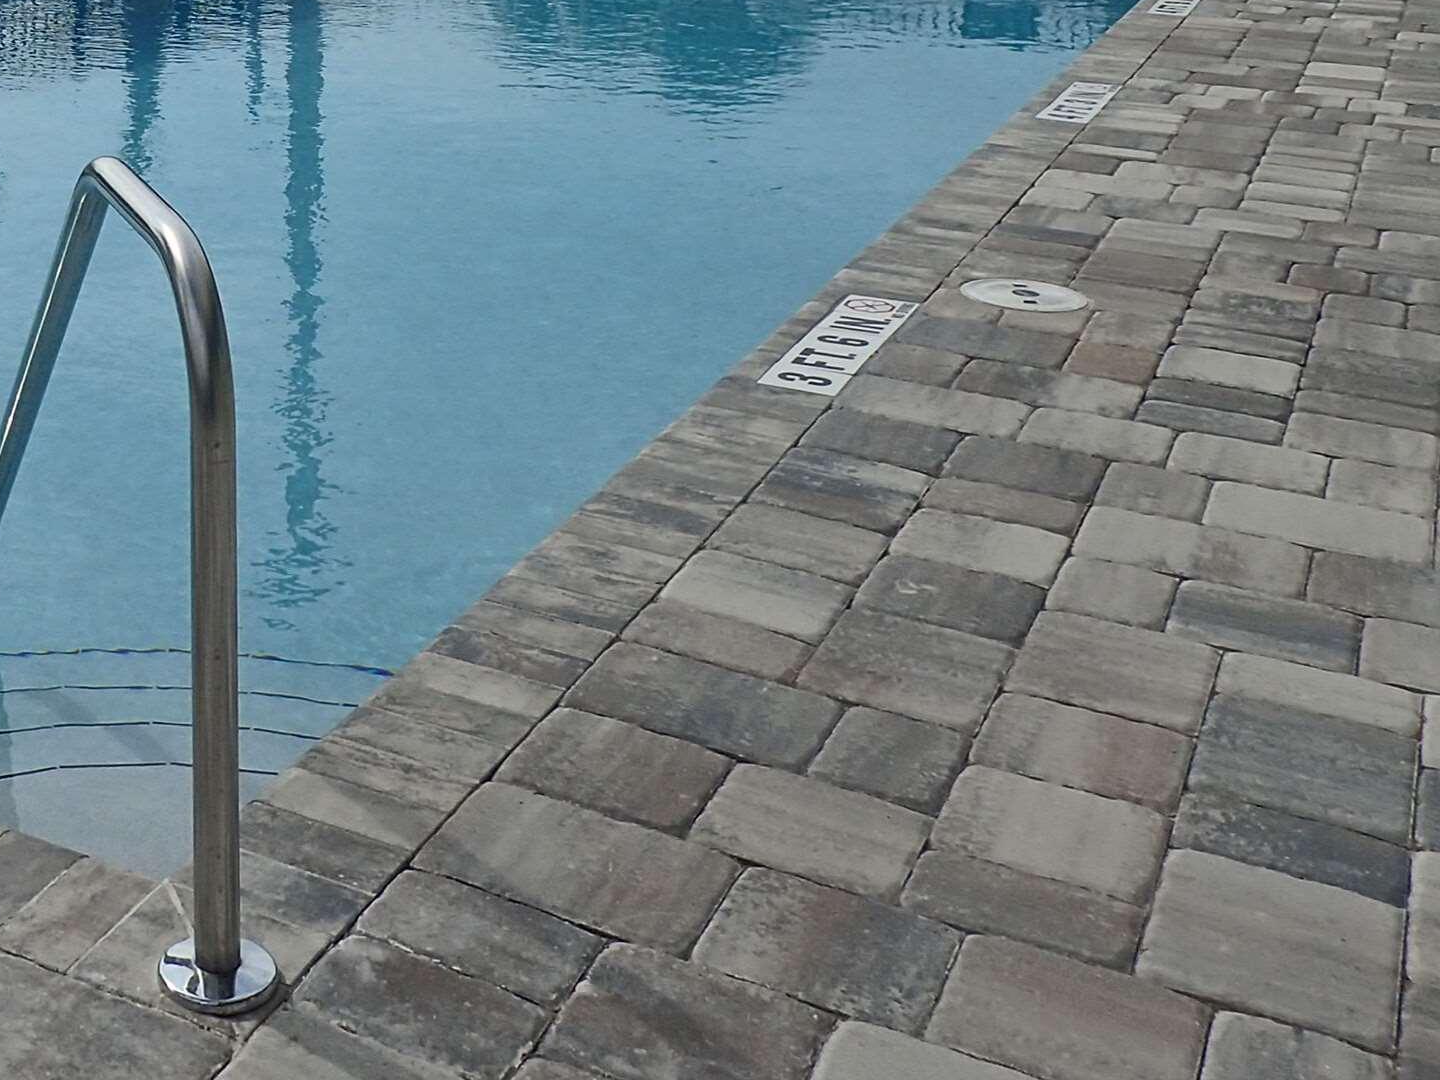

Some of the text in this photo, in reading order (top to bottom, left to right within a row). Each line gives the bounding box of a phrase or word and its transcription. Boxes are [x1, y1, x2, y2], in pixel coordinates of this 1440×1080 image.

[777, 316, 892, 387] 3 FT. 6 IN.
